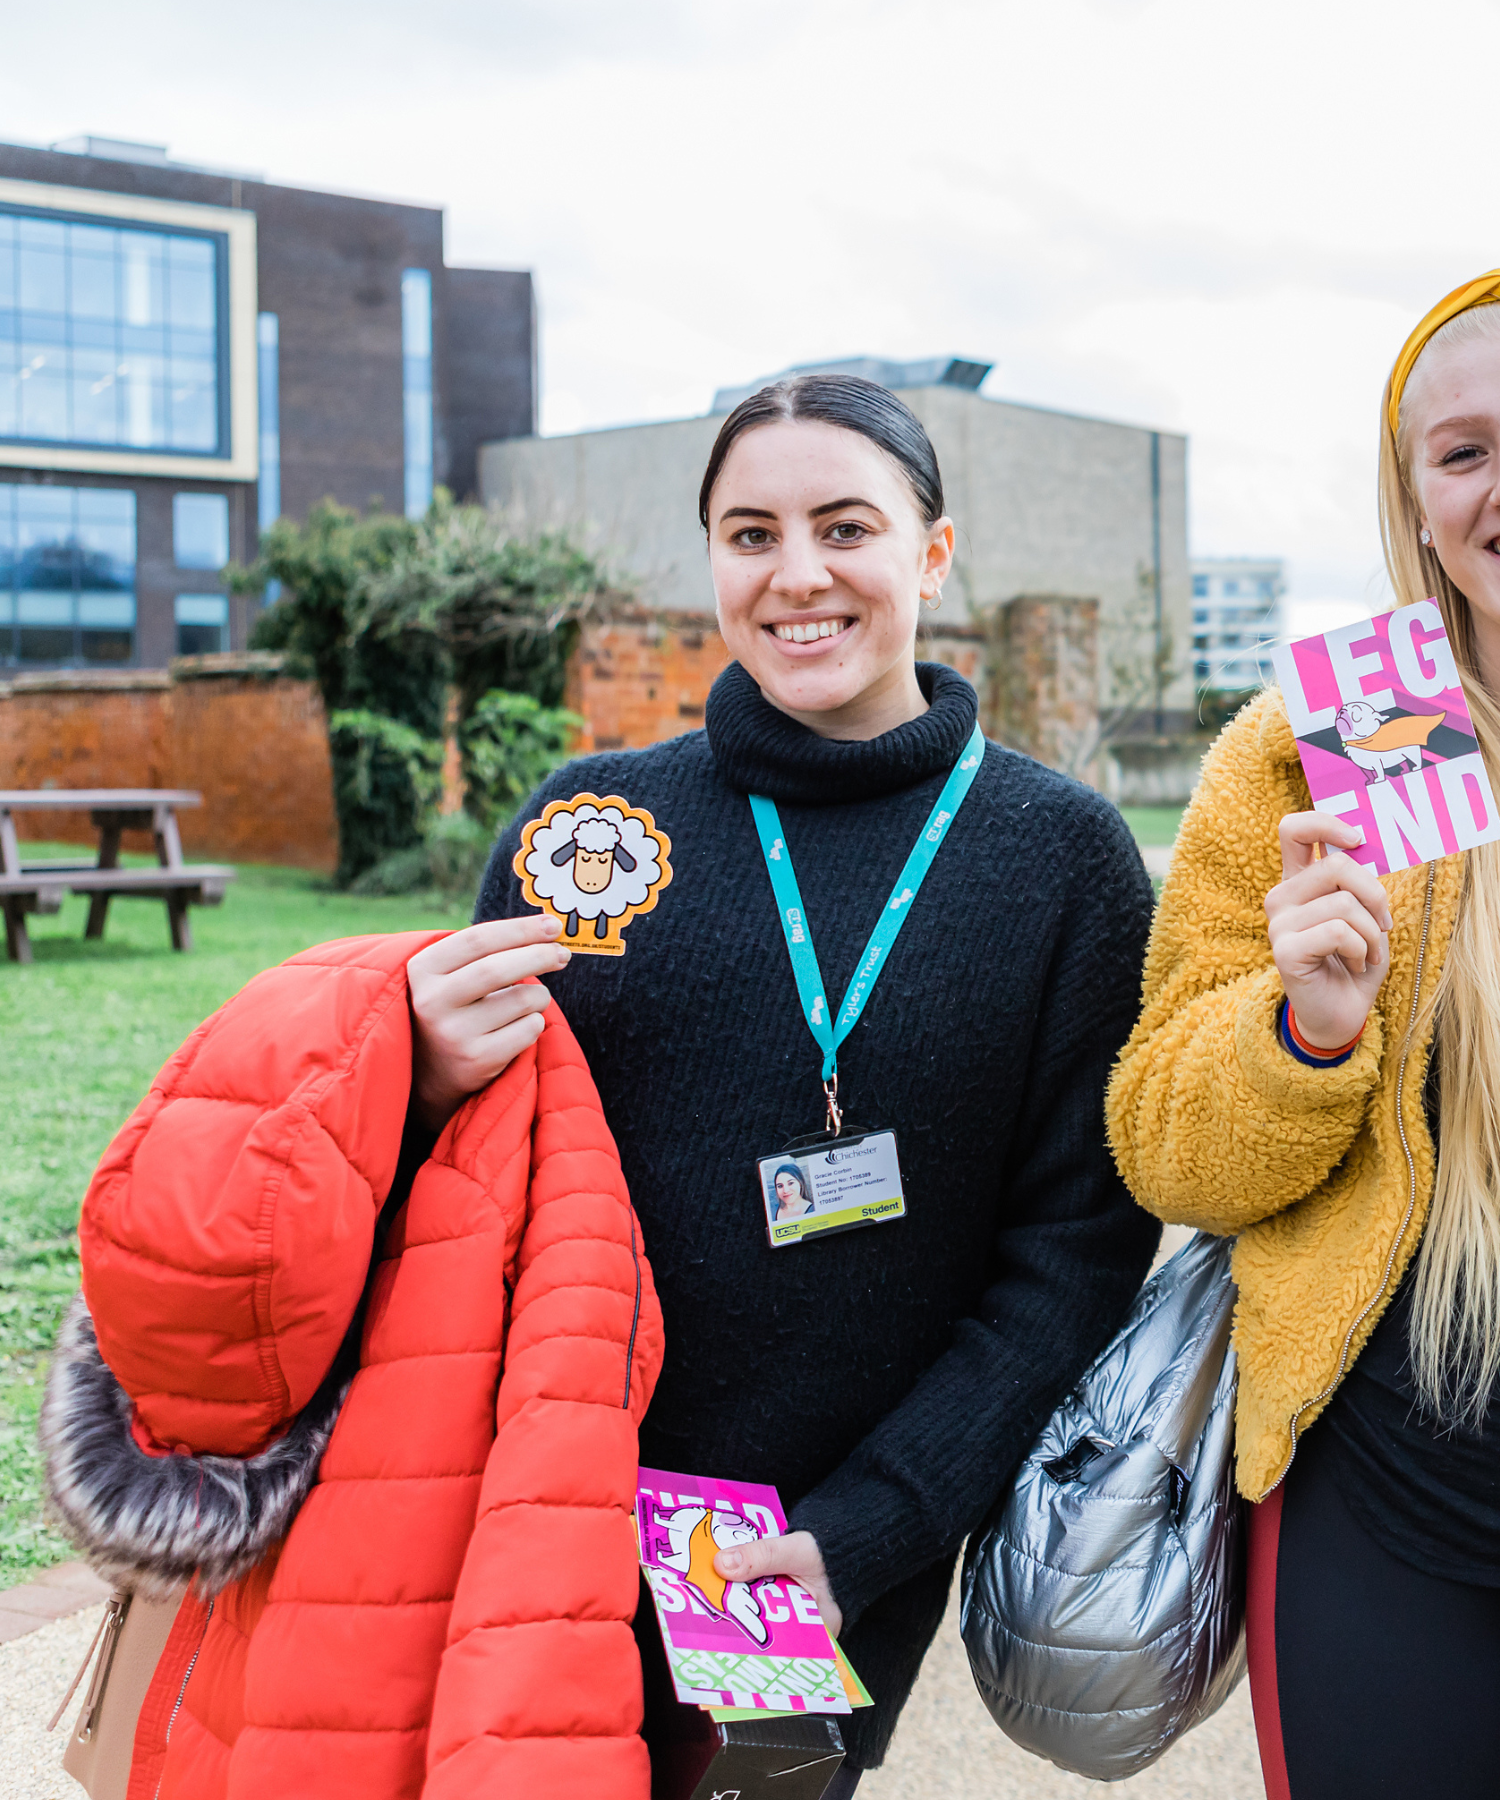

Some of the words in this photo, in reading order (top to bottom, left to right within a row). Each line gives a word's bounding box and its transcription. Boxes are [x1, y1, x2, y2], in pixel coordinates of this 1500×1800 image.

[1269, 600, 1462, 739] LEG
[842, 982, 865, 1025] Tyler's
[860, 945, 882, 978] Trust
[835, 1145, 877, 1161] Chichester
[815, 1179, 837, 1188] Student
[817, 1188, 836, 1197] Library
[838, 1182, 863, 1191] Borrower
[862, 1202, 899, 1217] Student
[650, 1569, 824, 1625] SCE
